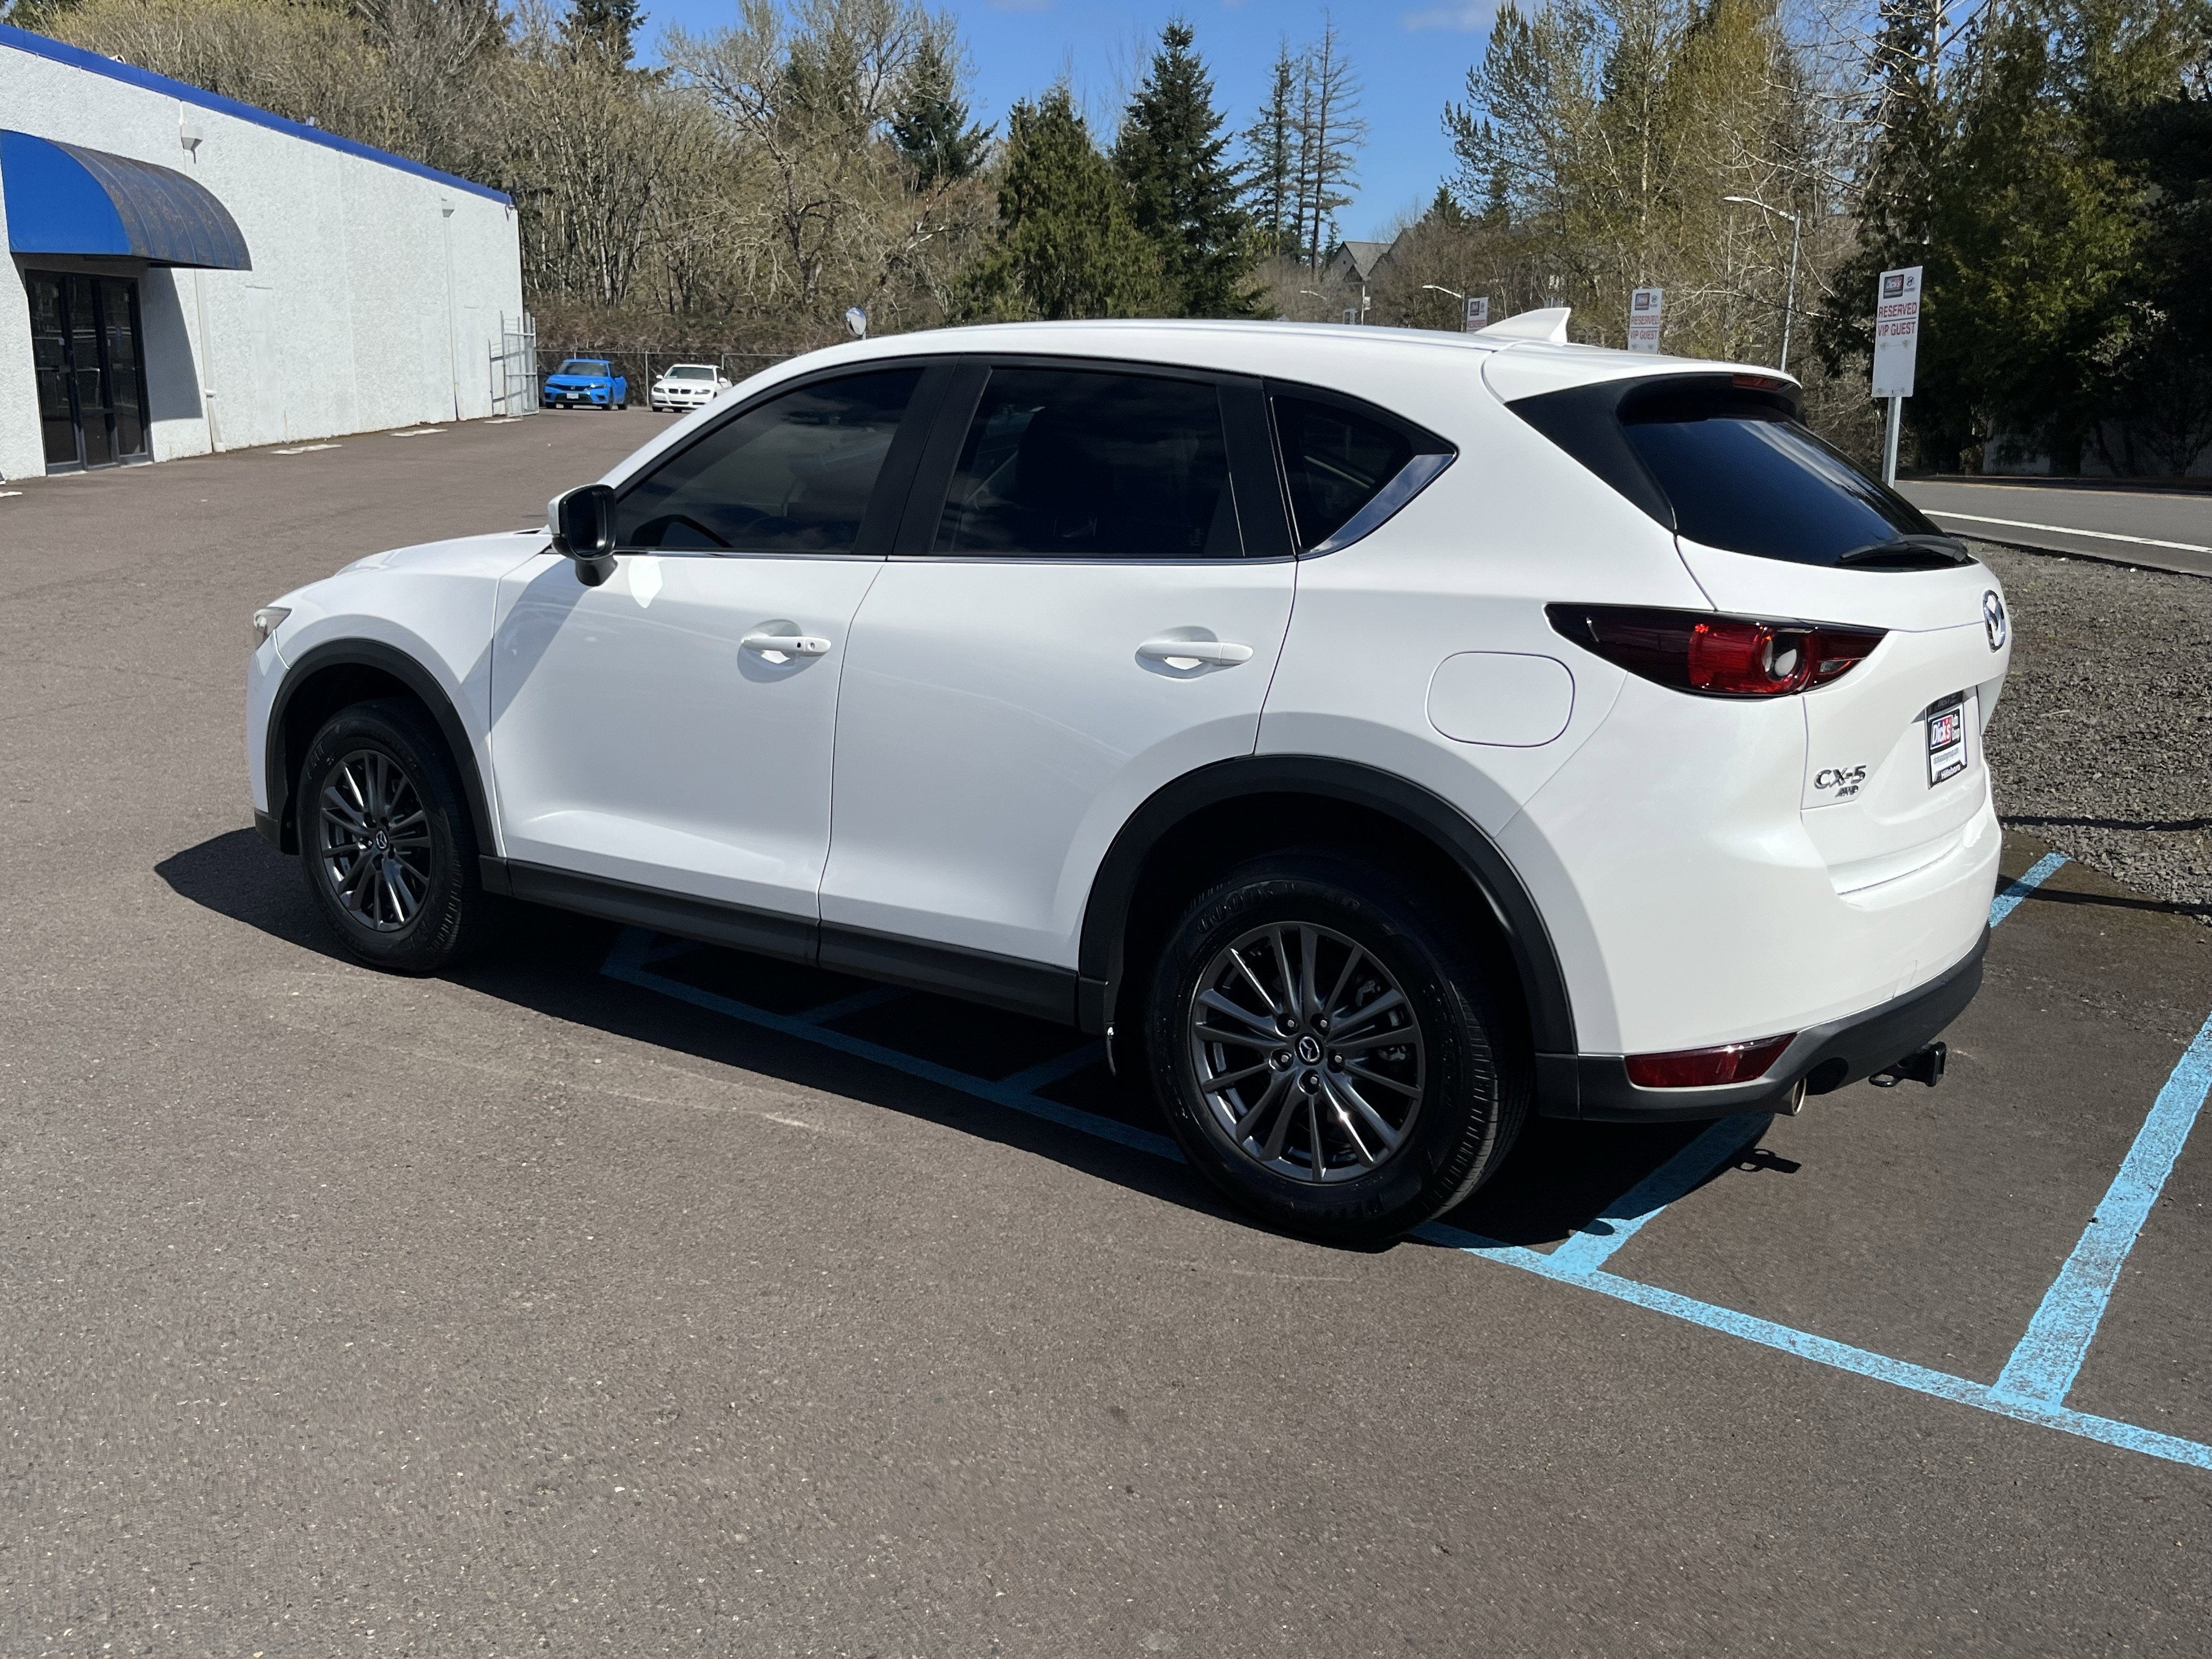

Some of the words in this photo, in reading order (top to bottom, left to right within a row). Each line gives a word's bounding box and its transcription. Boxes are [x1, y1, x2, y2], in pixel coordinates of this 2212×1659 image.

[1878, 302, 1917, 318] RESERVED
[1877, 324, 1889, 337] VIP
[1891, 321, 1916, 336] GUEST
[1932, 717, 1951, 745] Dick's
[1814, 765, 1866, 790] CX-5
